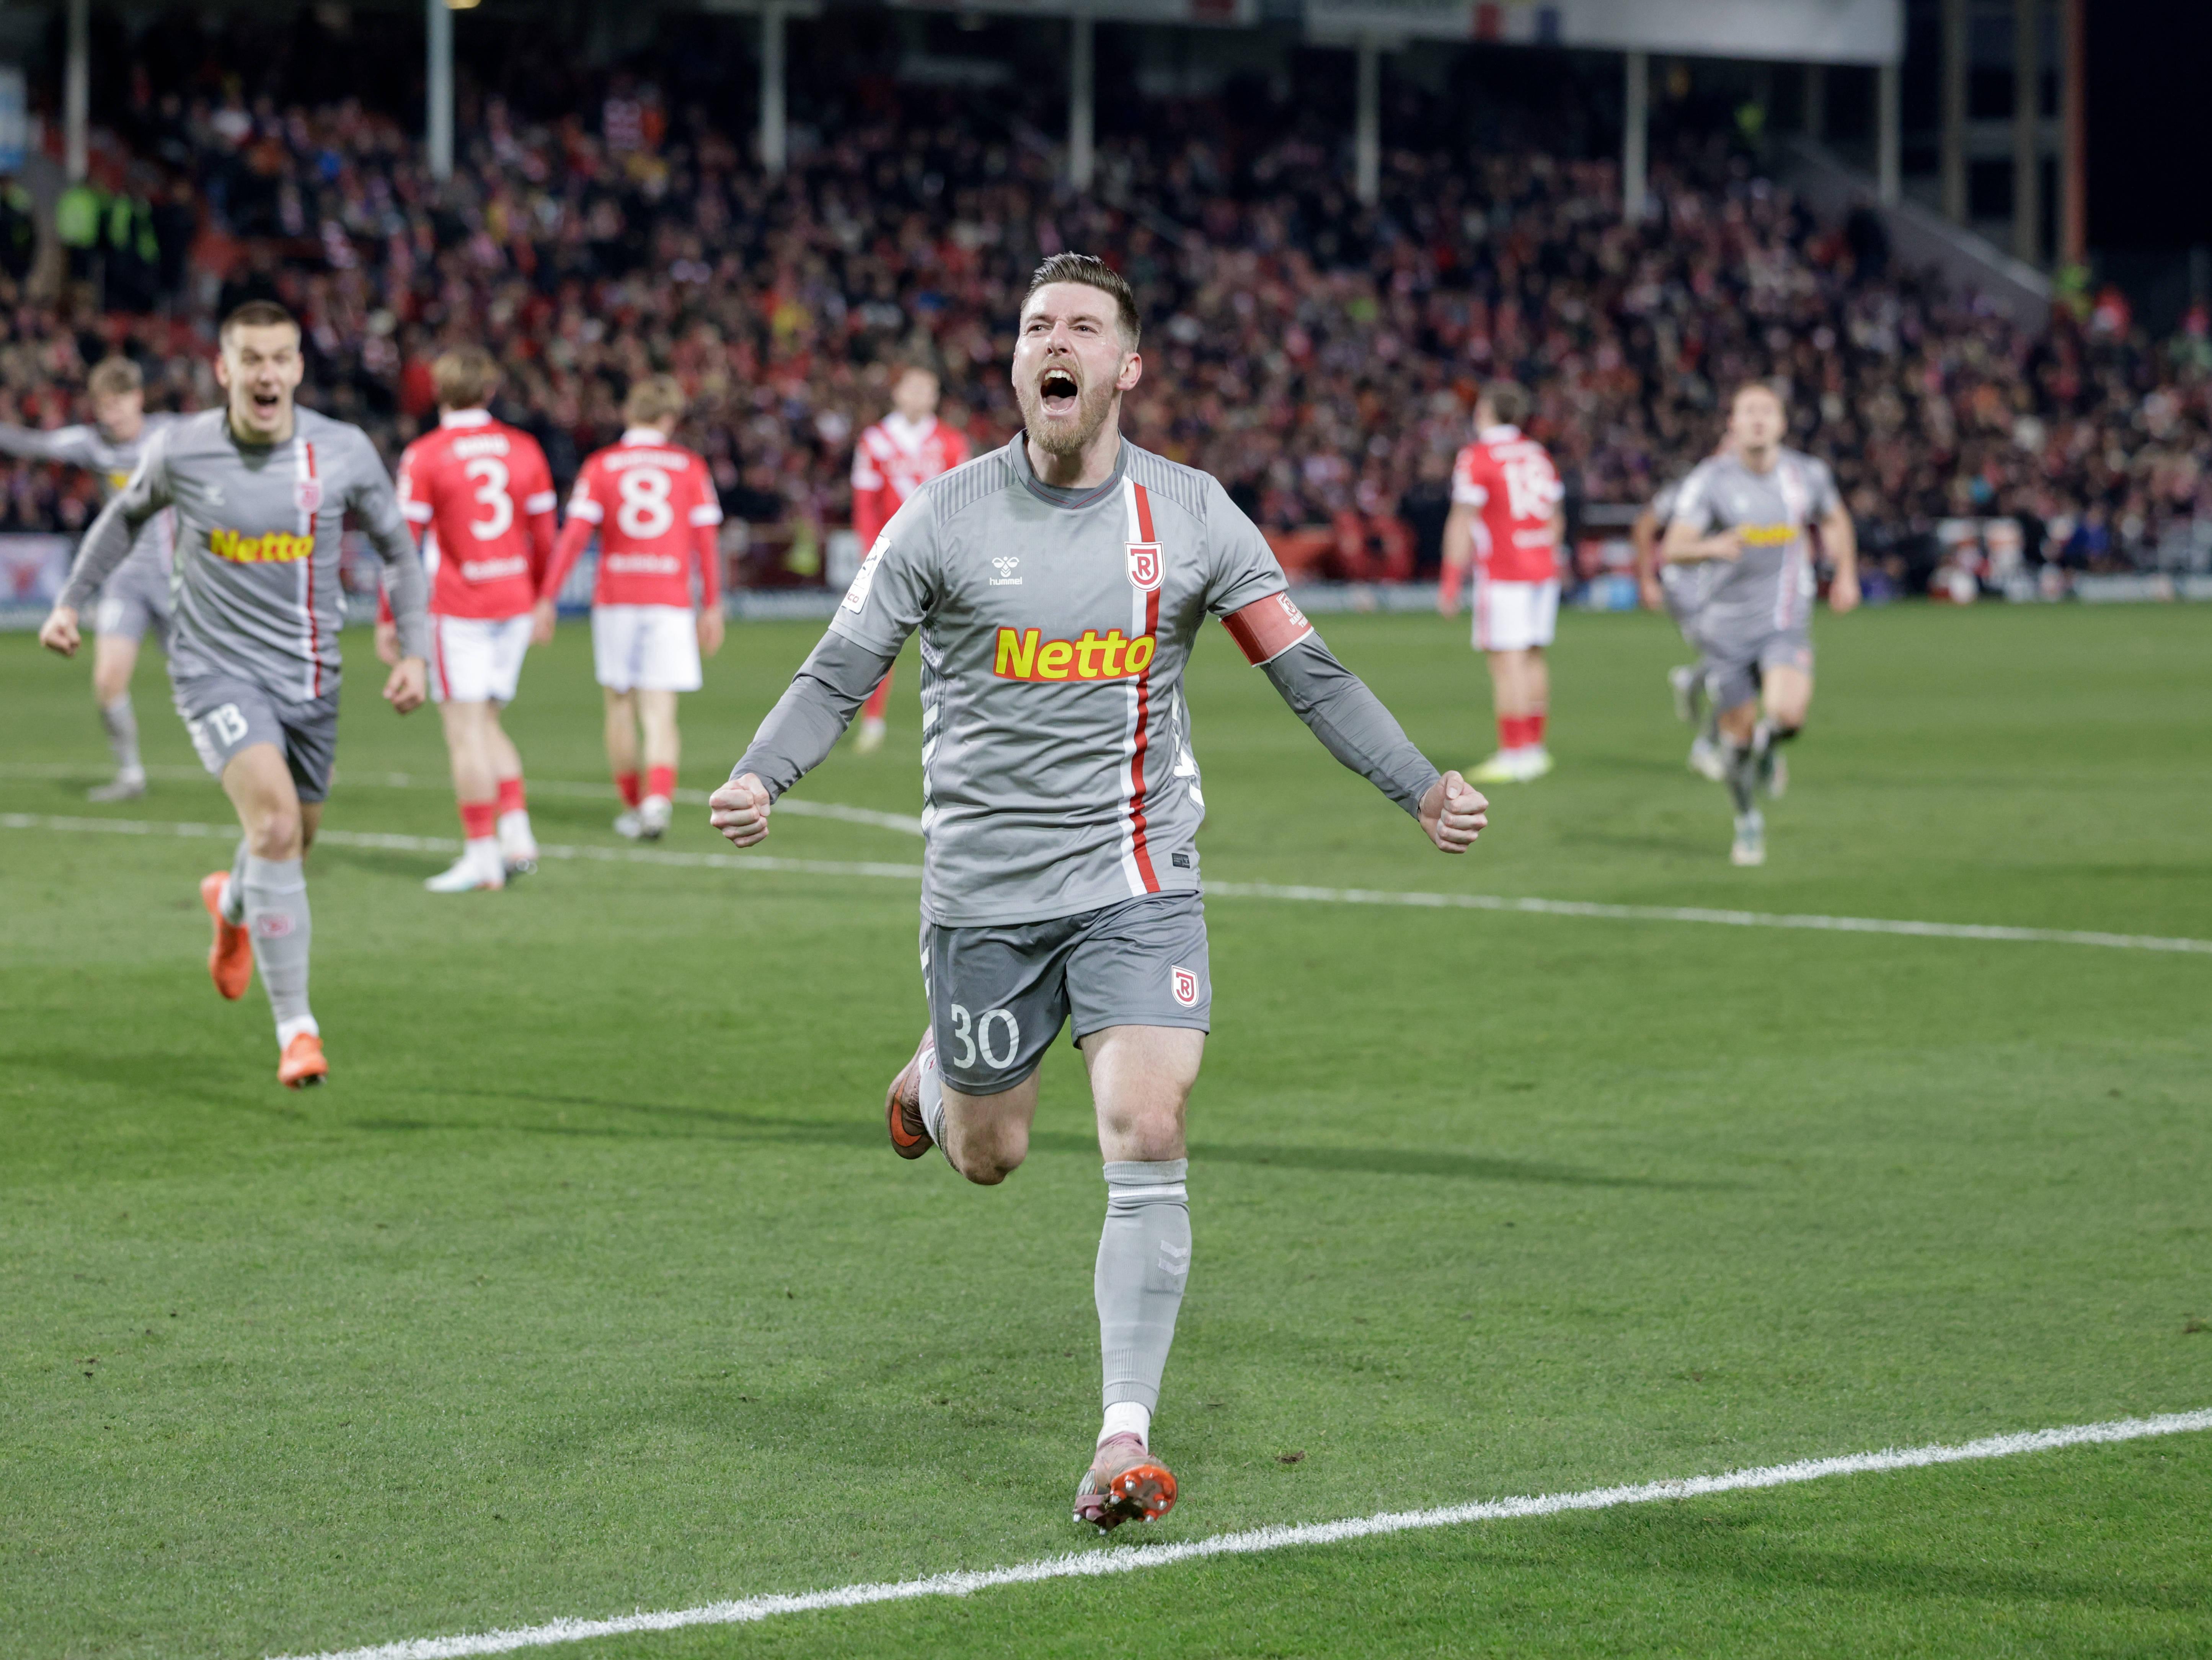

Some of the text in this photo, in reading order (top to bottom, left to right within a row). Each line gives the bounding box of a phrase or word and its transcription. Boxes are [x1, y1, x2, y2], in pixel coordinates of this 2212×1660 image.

[465, 458, 513, 541] 3
[617, 468, 674, 540] 8
[211, 528, 315, 562] Netto
[989, 576, 1022, 585] hummel
[995, 629, 1155, 680] Netto
[207, 702, 249, 747] 13
[951, 1003, 1019, 1069] 30
